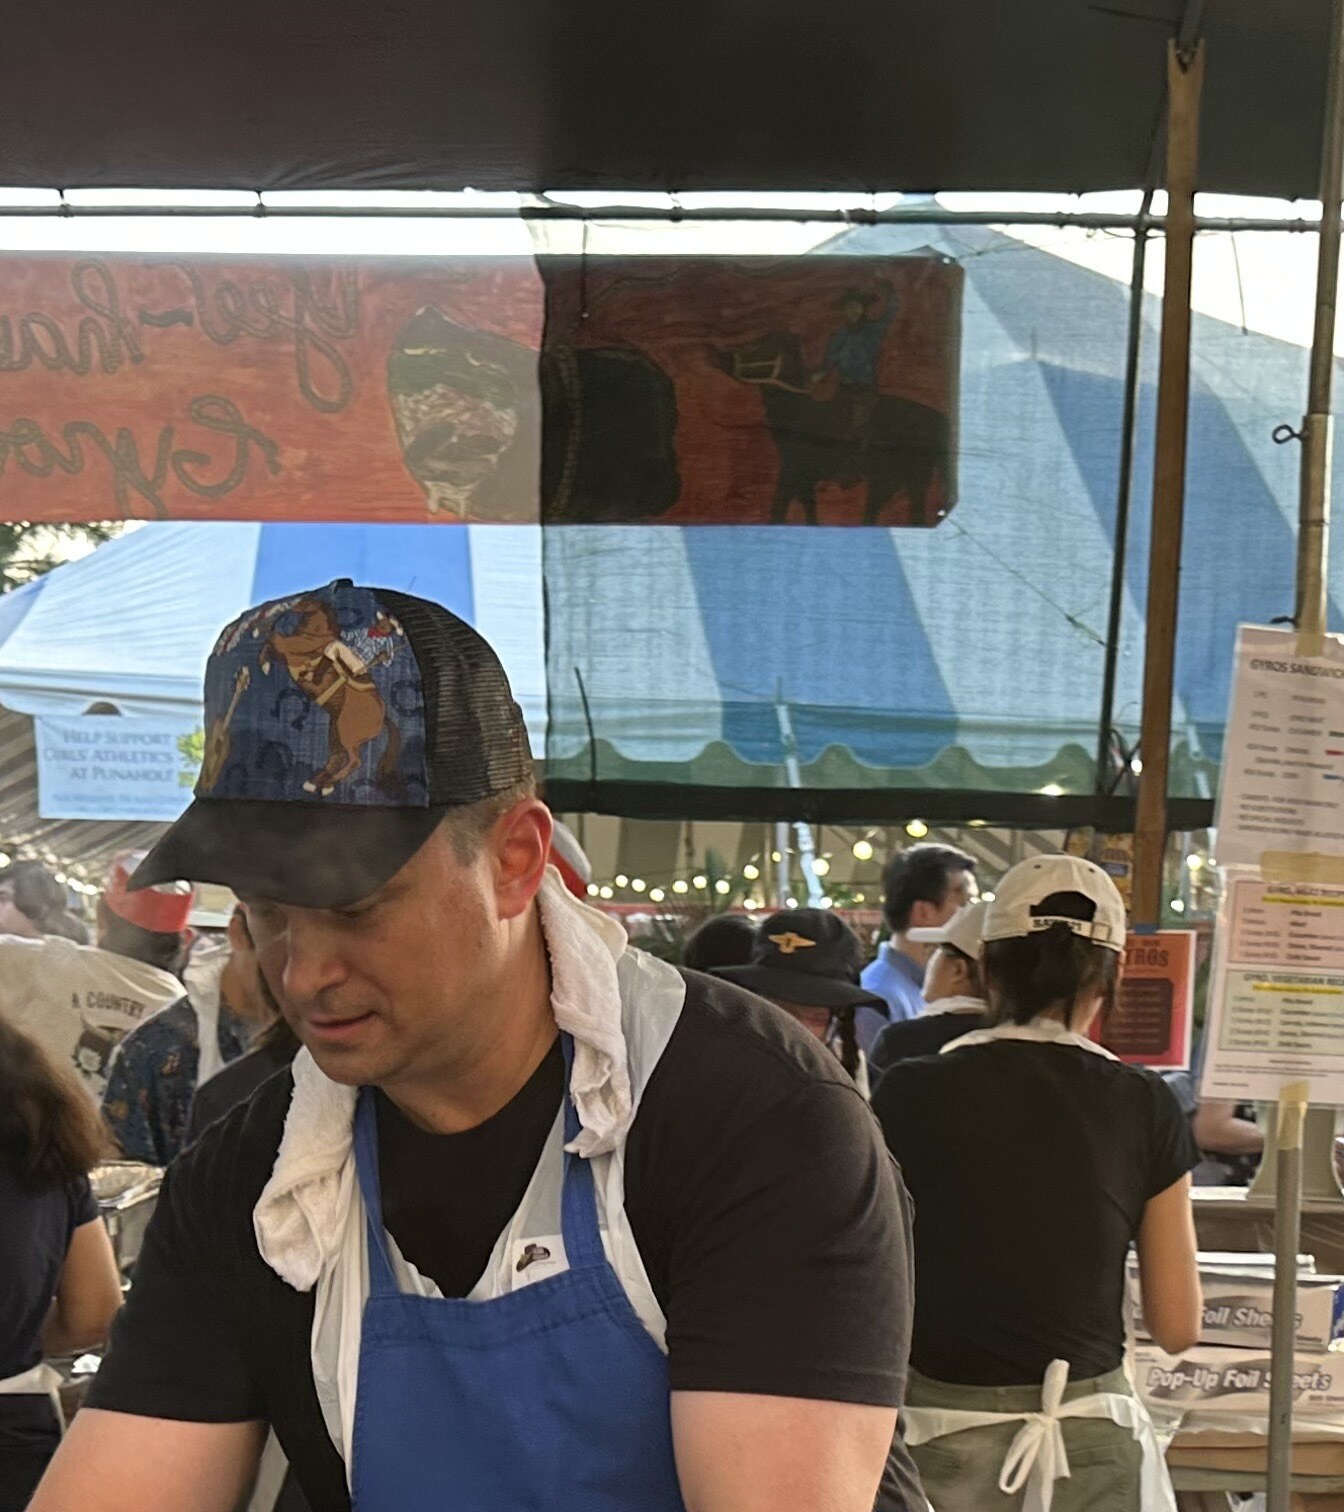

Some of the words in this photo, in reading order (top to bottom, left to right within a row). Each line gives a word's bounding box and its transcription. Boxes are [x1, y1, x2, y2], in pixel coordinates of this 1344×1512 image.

[1249, 658, 1288, 673] GYROS
[1147, 1366, 1220, 1391] Pop-Up
[1223, 1368, 1258, 1389] Foil
[1262, 1370, 1333, 1392] Seets
